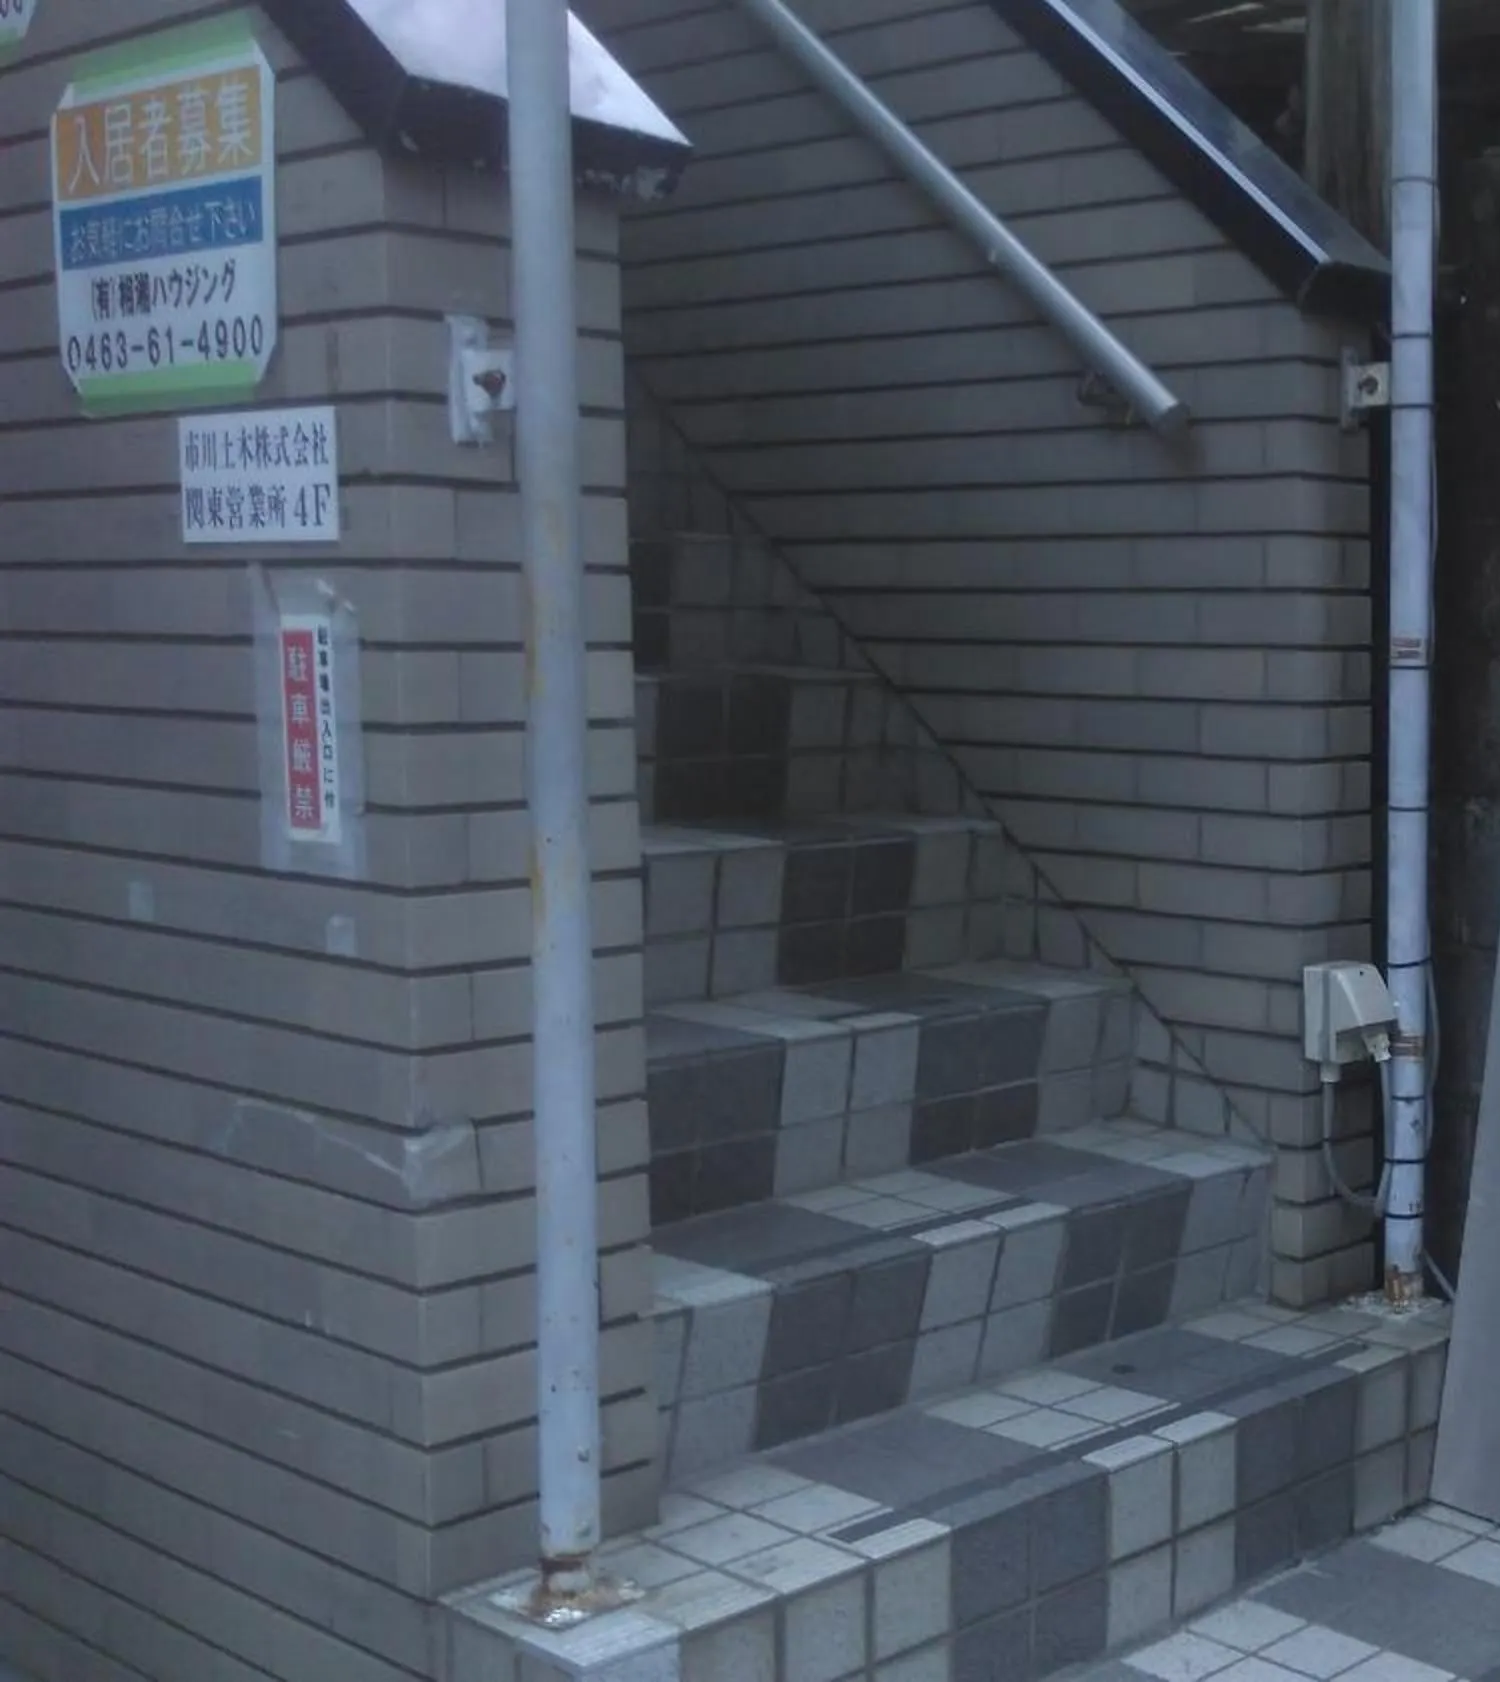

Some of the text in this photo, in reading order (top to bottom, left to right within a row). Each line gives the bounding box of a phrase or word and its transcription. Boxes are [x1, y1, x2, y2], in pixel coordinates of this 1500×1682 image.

[67, 79, 255, 195] 入居者募集
[66, 314, 264, 372] 0463-61-4900
[185, 421, 330, 473] 市川土木株式会社
[287, 645, 315, 820] 駐車厳禁
